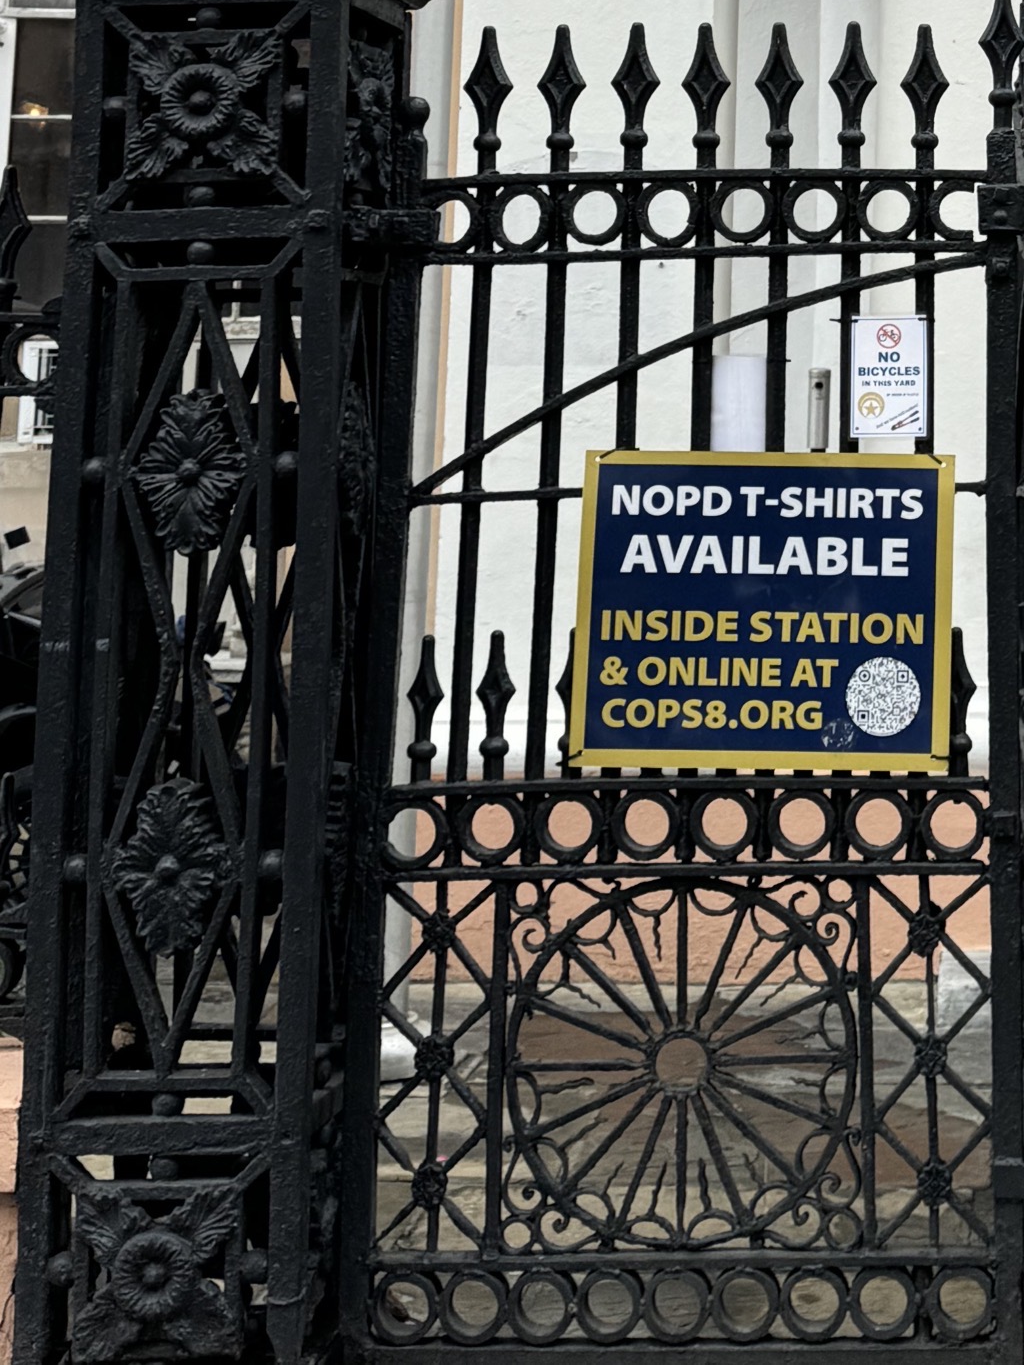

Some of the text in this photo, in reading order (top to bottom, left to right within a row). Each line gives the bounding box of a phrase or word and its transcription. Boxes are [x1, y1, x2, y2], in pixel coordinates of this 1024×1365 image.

[858, 366, 921, 376] BICYCLES
[878, 351, 901, 363] NO
[894, 379, 916, 387] YARD
[611, 484, 924, 520] NOPD T-SHIRTS
[619, 534, 910, 577] AVAILABLE
[600, 609, 925, 645] INSIDE STATION
[599, 655, 839, 688] & ONLINE AT
[601, 698, 824, 731] COPS8.ORG
